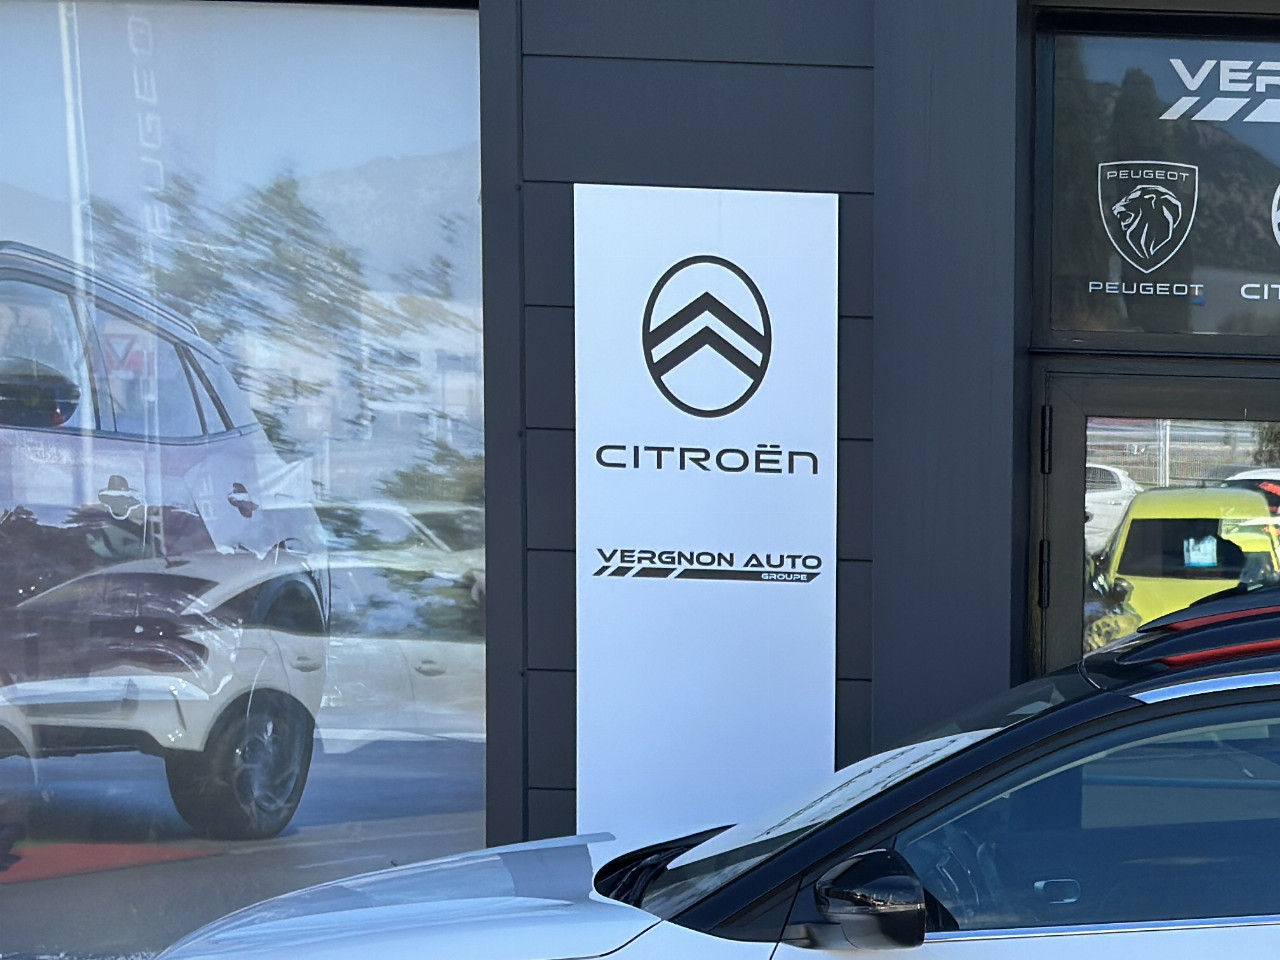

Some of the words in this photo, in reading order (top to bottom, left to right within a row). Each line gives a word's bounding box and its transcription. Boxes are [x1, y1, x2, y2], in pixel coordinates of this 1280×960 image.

[1106, 169, 1190, 182] PEUGEOT
[1088, 281, 1205, 296] PEUGEOT
[596, 548, 735, 567] VERGNON
[743, 553, 823, 570] AUTO
[761, 572, 808, 581] GROUPE
